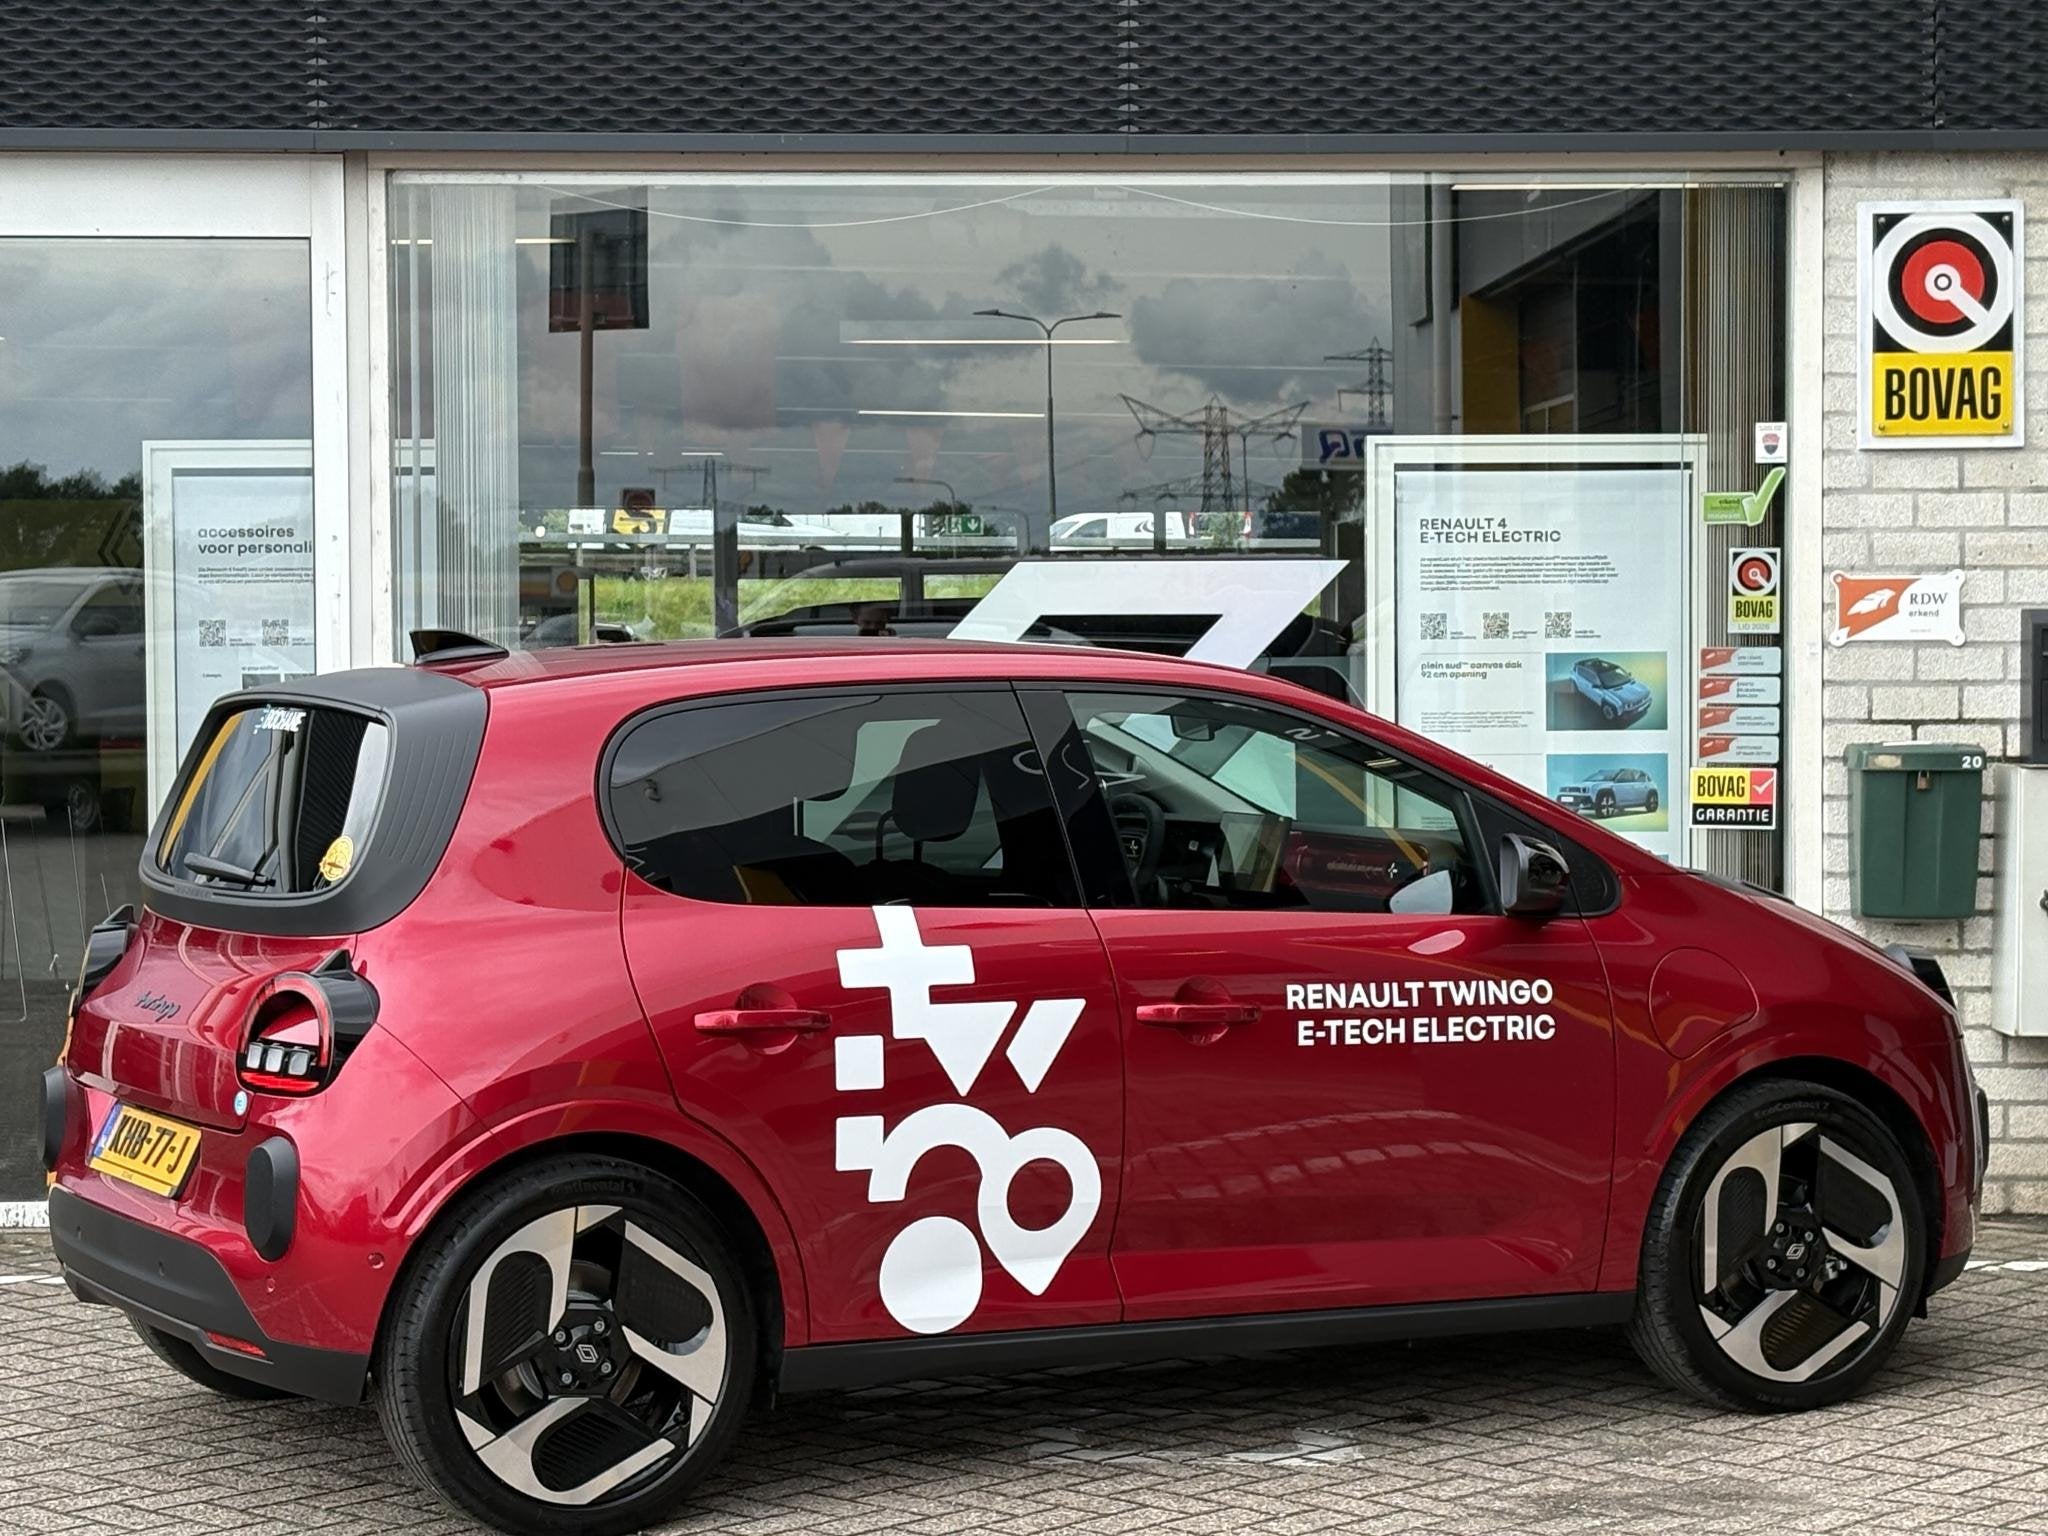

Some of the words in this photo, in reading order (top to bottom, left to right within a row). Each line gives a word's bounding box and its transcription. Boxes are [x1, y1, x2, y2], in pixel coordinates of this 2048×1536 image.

[1885, 367, 2001, 420] BOVAG
[1420, 518, 1494, 530] RENAULT
[1498, 518, 1507, 529] 4
[198, 525, 294, 538] accessoires
[1420, 531, 1478, 543] E-TECH
[1483, 530, 1561, 543] ELECTRIC
[198, 543, 234, 554] voor
[238, 540, 312, 557] personali
[1909, 592, 1948, 605] RDW
[1736, 600, 1773, 618] BOVAG
[1909, 609, 1939, 617] erkend
[1421, 661, 1444, 672] plein
[1470, 661, 1503, 670] canvas
[1505, 660, 1522, 669] dak
[1421, 671, 1432, 679] 92
[1449, 671, 1487, 680] opening
[1962, 756, 1982, 768] 20
[1697, 775, 1745, 797] BOVAG
[1696, 808, 1770, 822] GARANTIE
[1286, 982, 1424, 1010] RENAULT
[1429, 979, 1553, 1006] TWINGO
[1298, 1018, 1405, 1046] E-TECH
[1413, 1014, 1556, 1043] ELECTRIC
